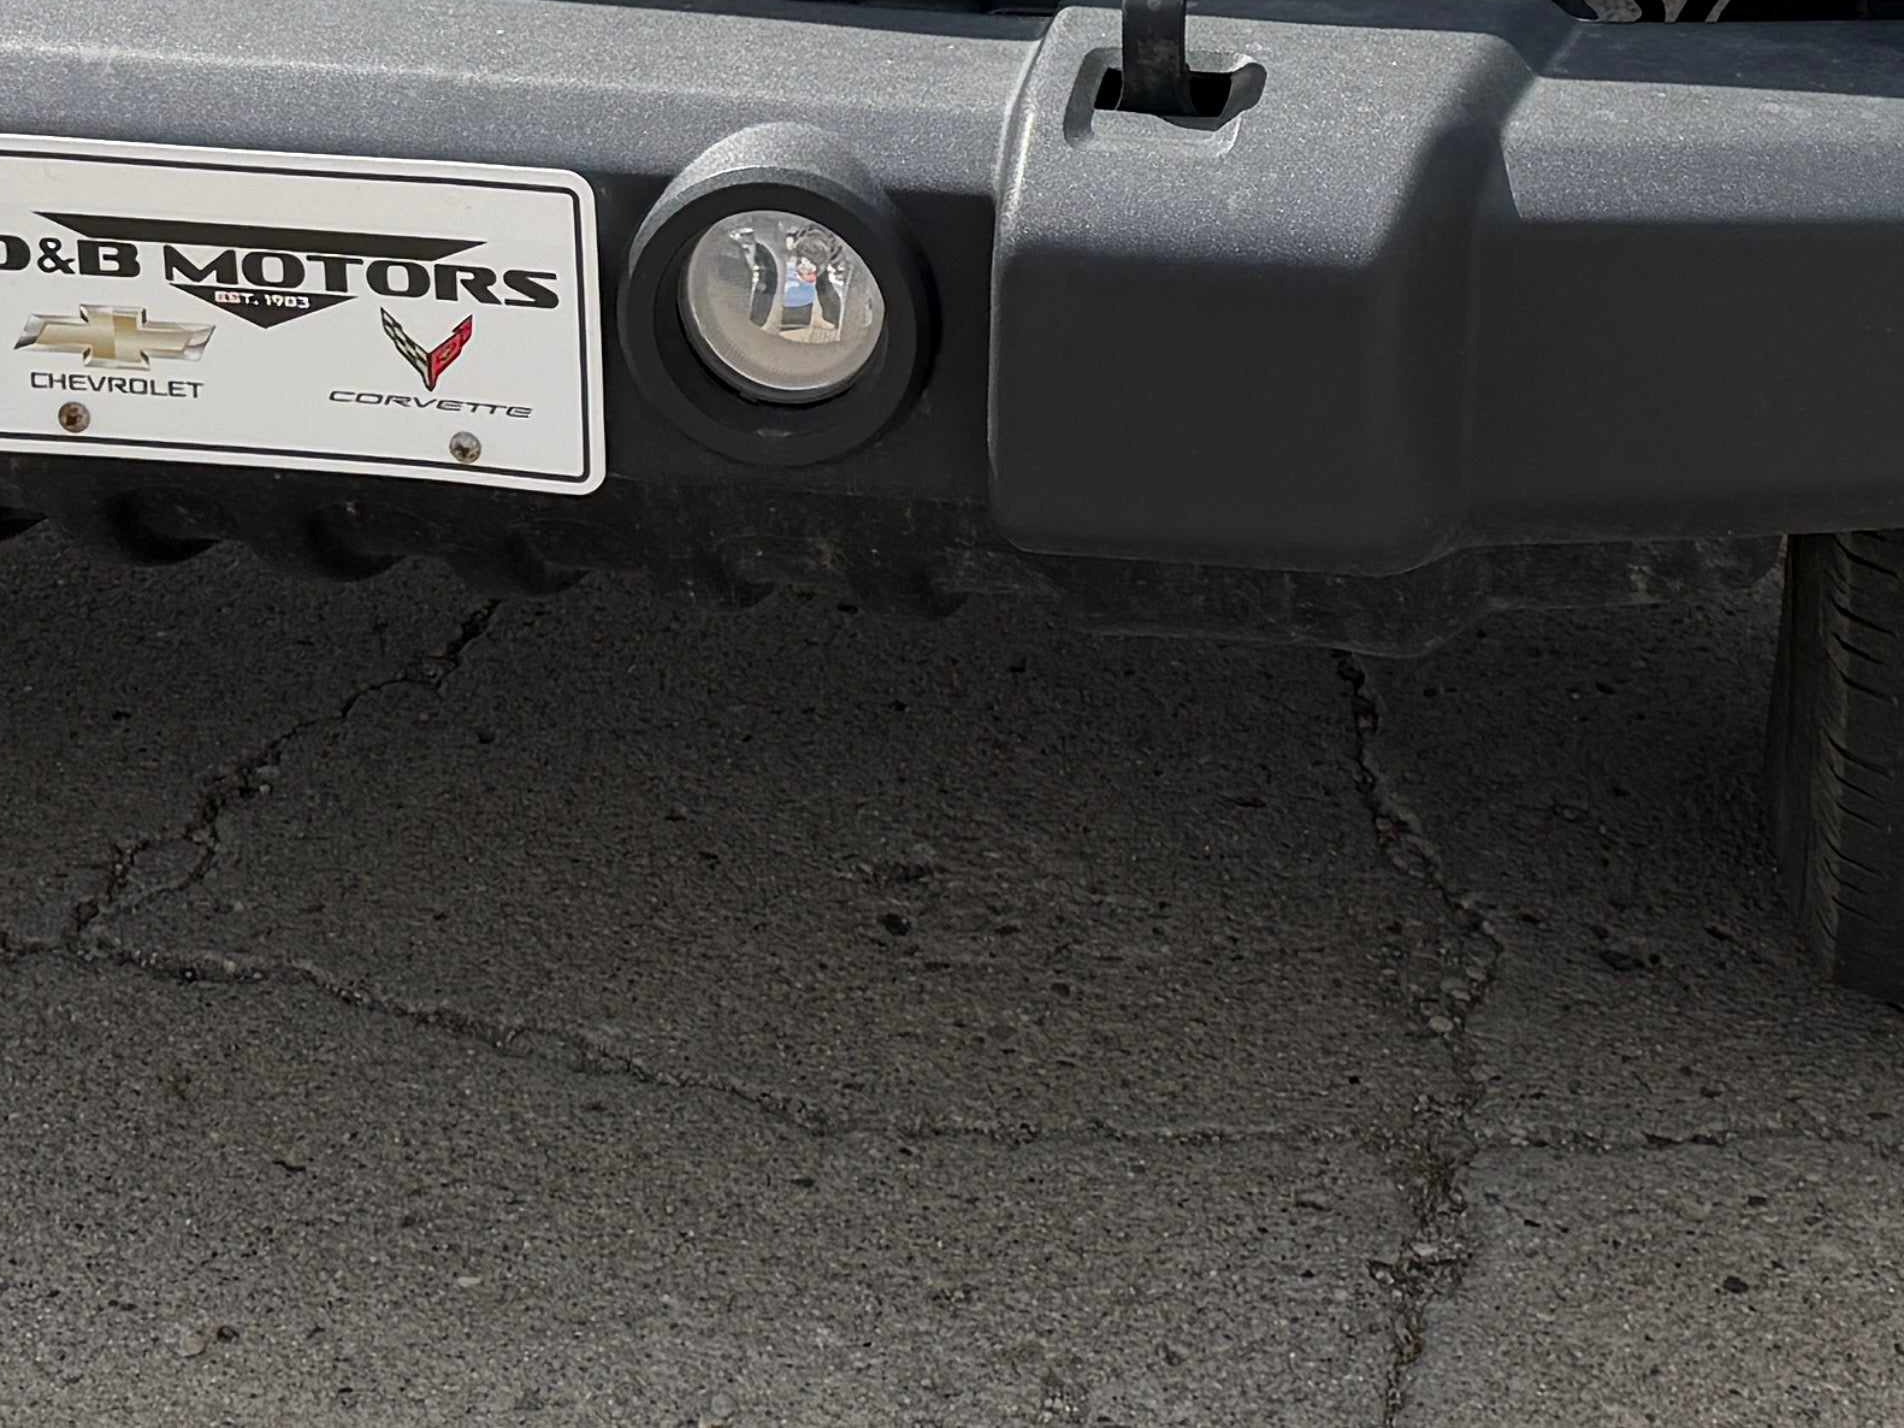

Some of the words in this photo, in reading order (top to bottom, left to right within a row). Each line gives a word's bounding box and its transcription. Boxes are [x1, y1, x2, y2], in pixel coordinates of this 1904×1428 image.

[163, 244, 559, 309] MOTORS
[30, 371, 204, 399] CHEVROLET
[328, 390, 533, 419] CORVETTE
